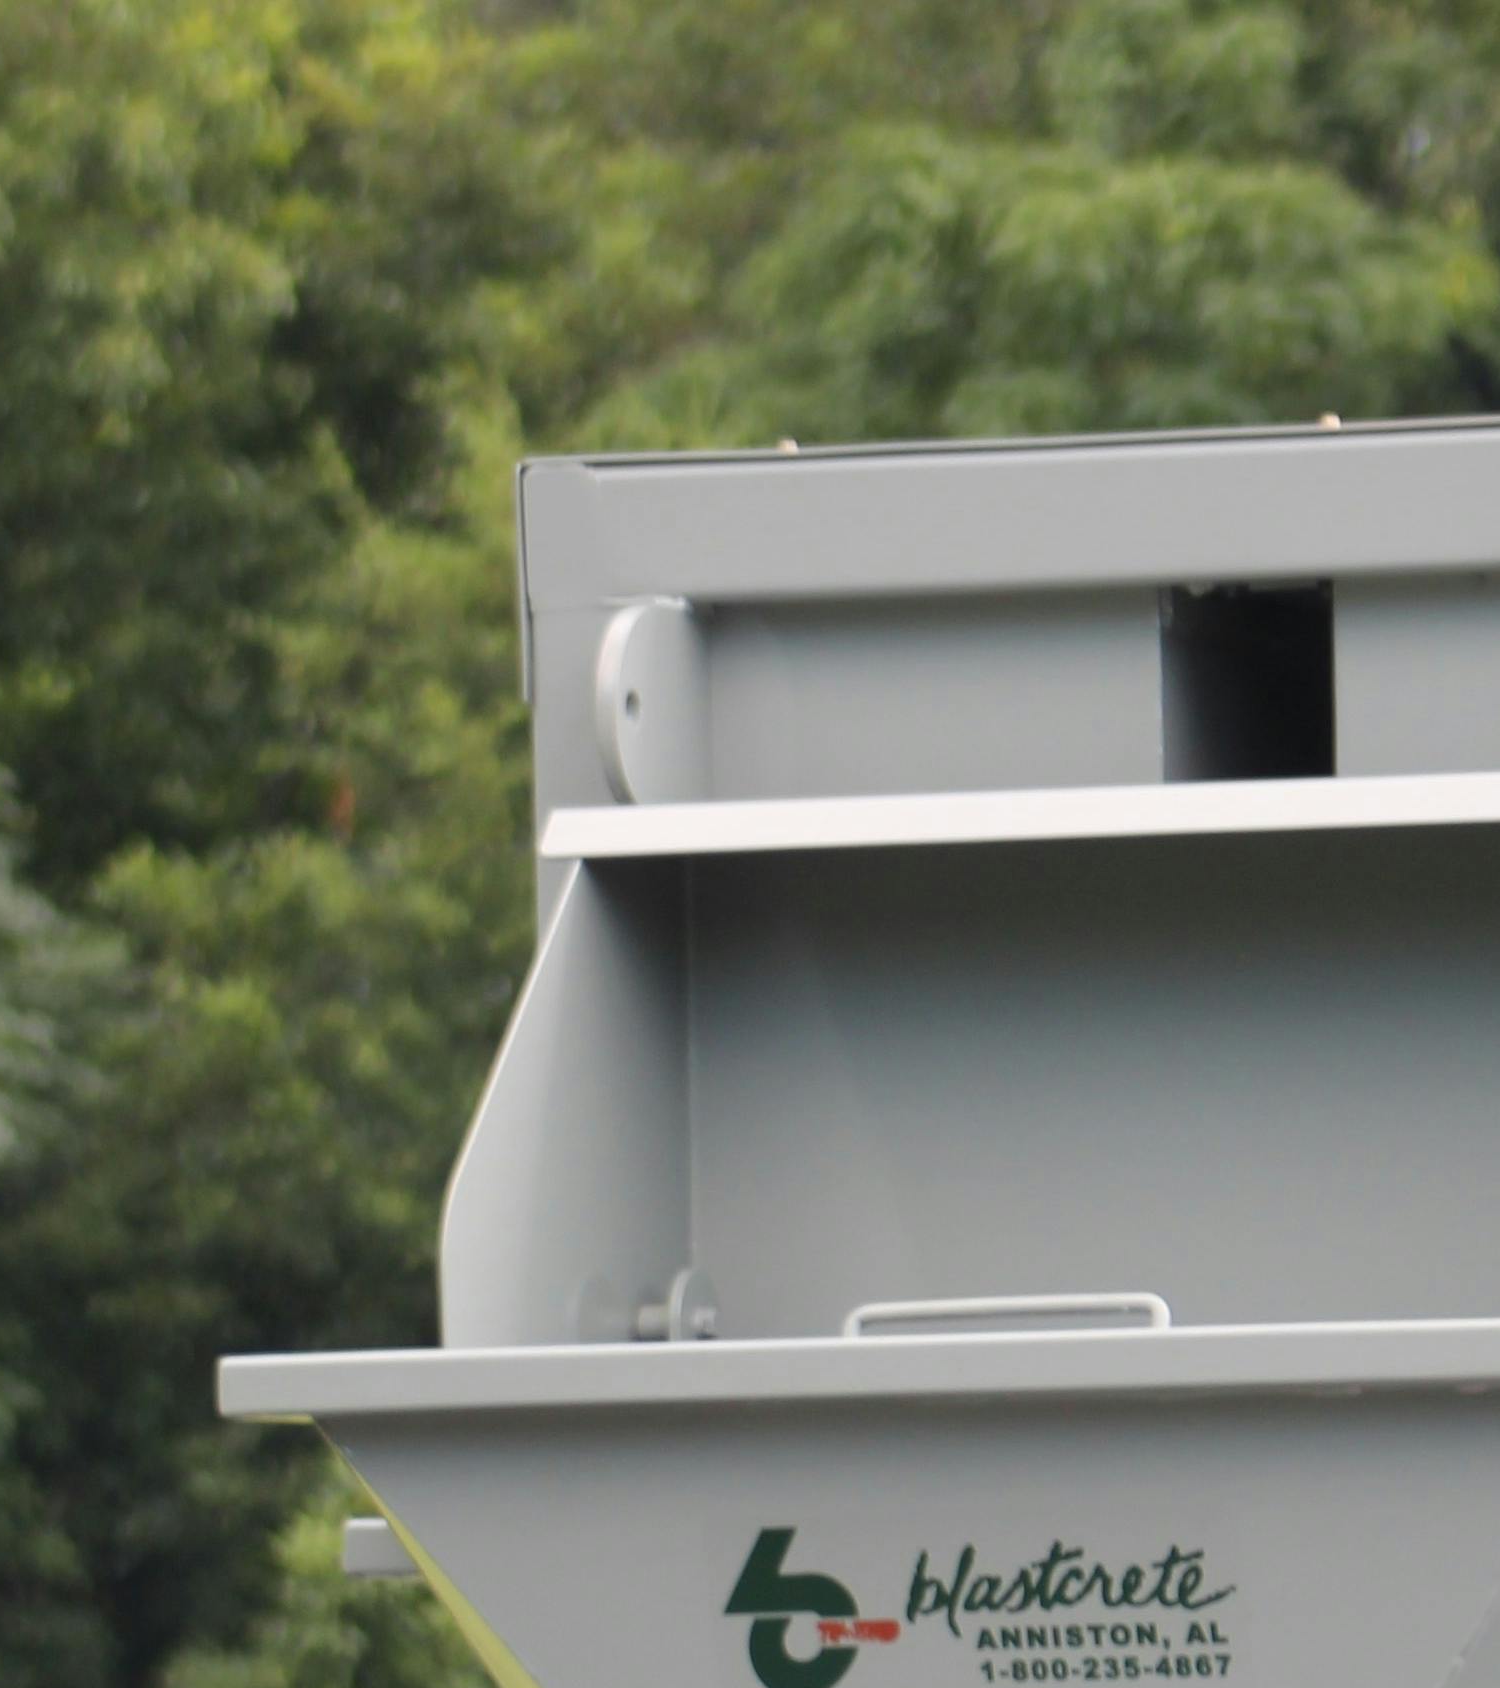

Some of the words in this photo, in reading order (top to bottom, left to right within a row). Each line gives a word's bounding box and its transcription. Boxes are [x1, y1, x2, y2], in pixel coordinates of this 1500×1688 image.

[906, 1540, 1237, 1638] blastcrete
[977, 1622, 1171, 1650] ANNISTON,
[1186, 1620, 1229, 1645] AL
[979, 1653, 1232, 1683] 1-800-235-4867
